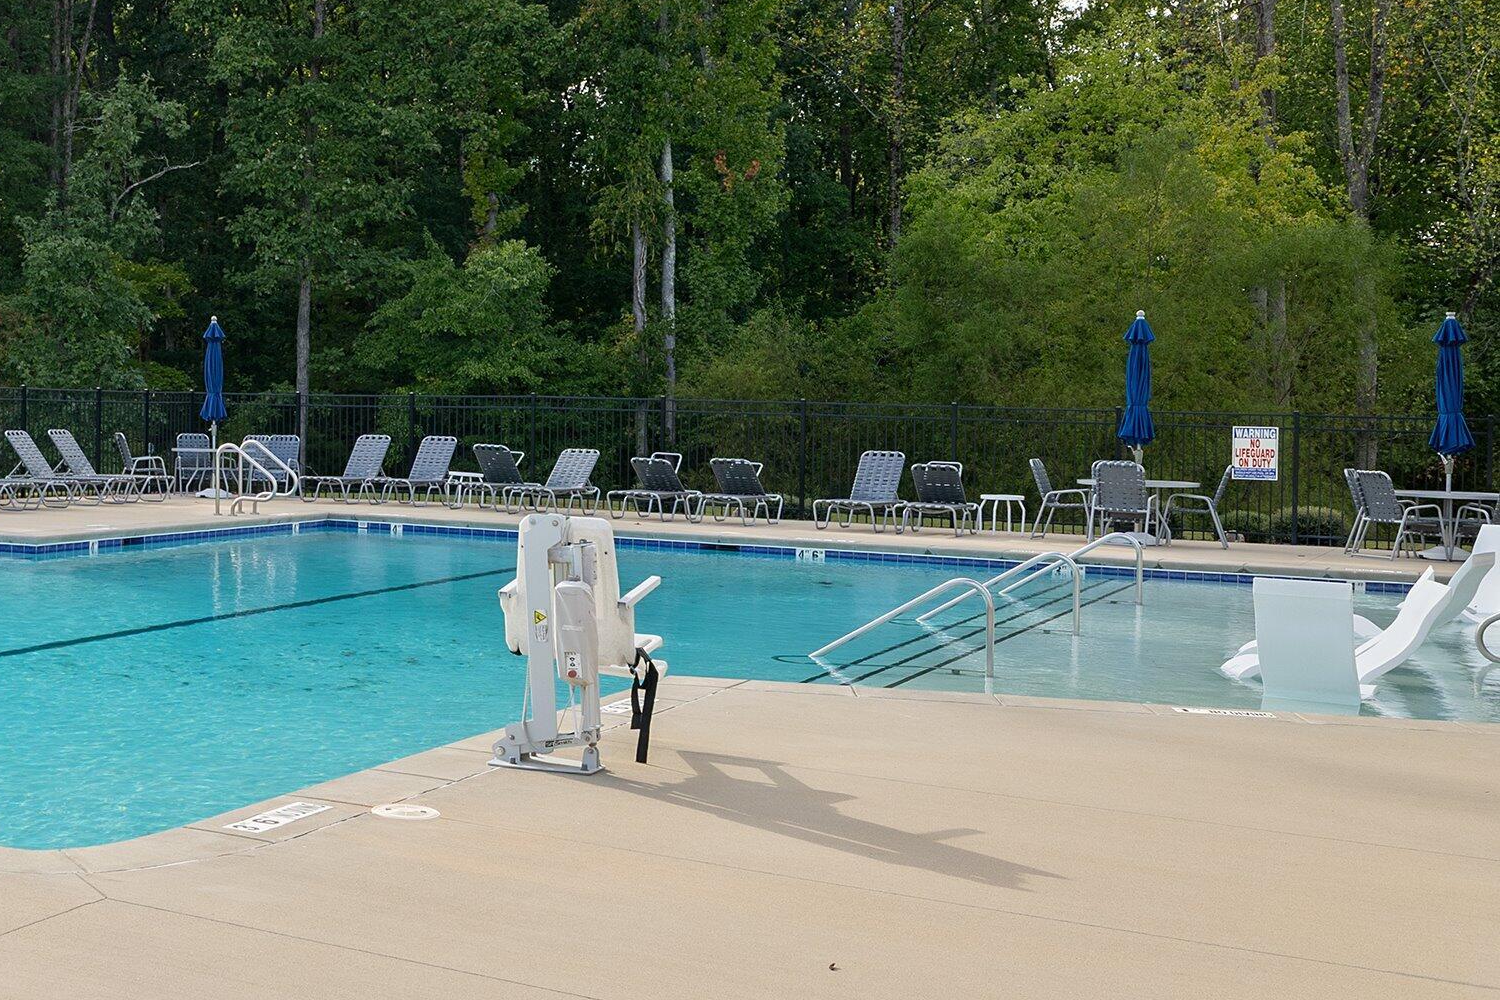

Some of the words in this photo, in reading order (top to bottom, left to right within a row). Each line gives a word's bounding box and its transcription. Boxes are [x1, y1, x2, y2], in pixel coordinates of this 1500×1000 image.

[1235, 428, 1276, 439] WARNING
[1250, 439, 1261, 448] NO
[1235, 448, 1276, 459] LIFEGUARD
[1238, 458, 1249, 467] ON
[1252, 458, 1272, 468] DUTY
